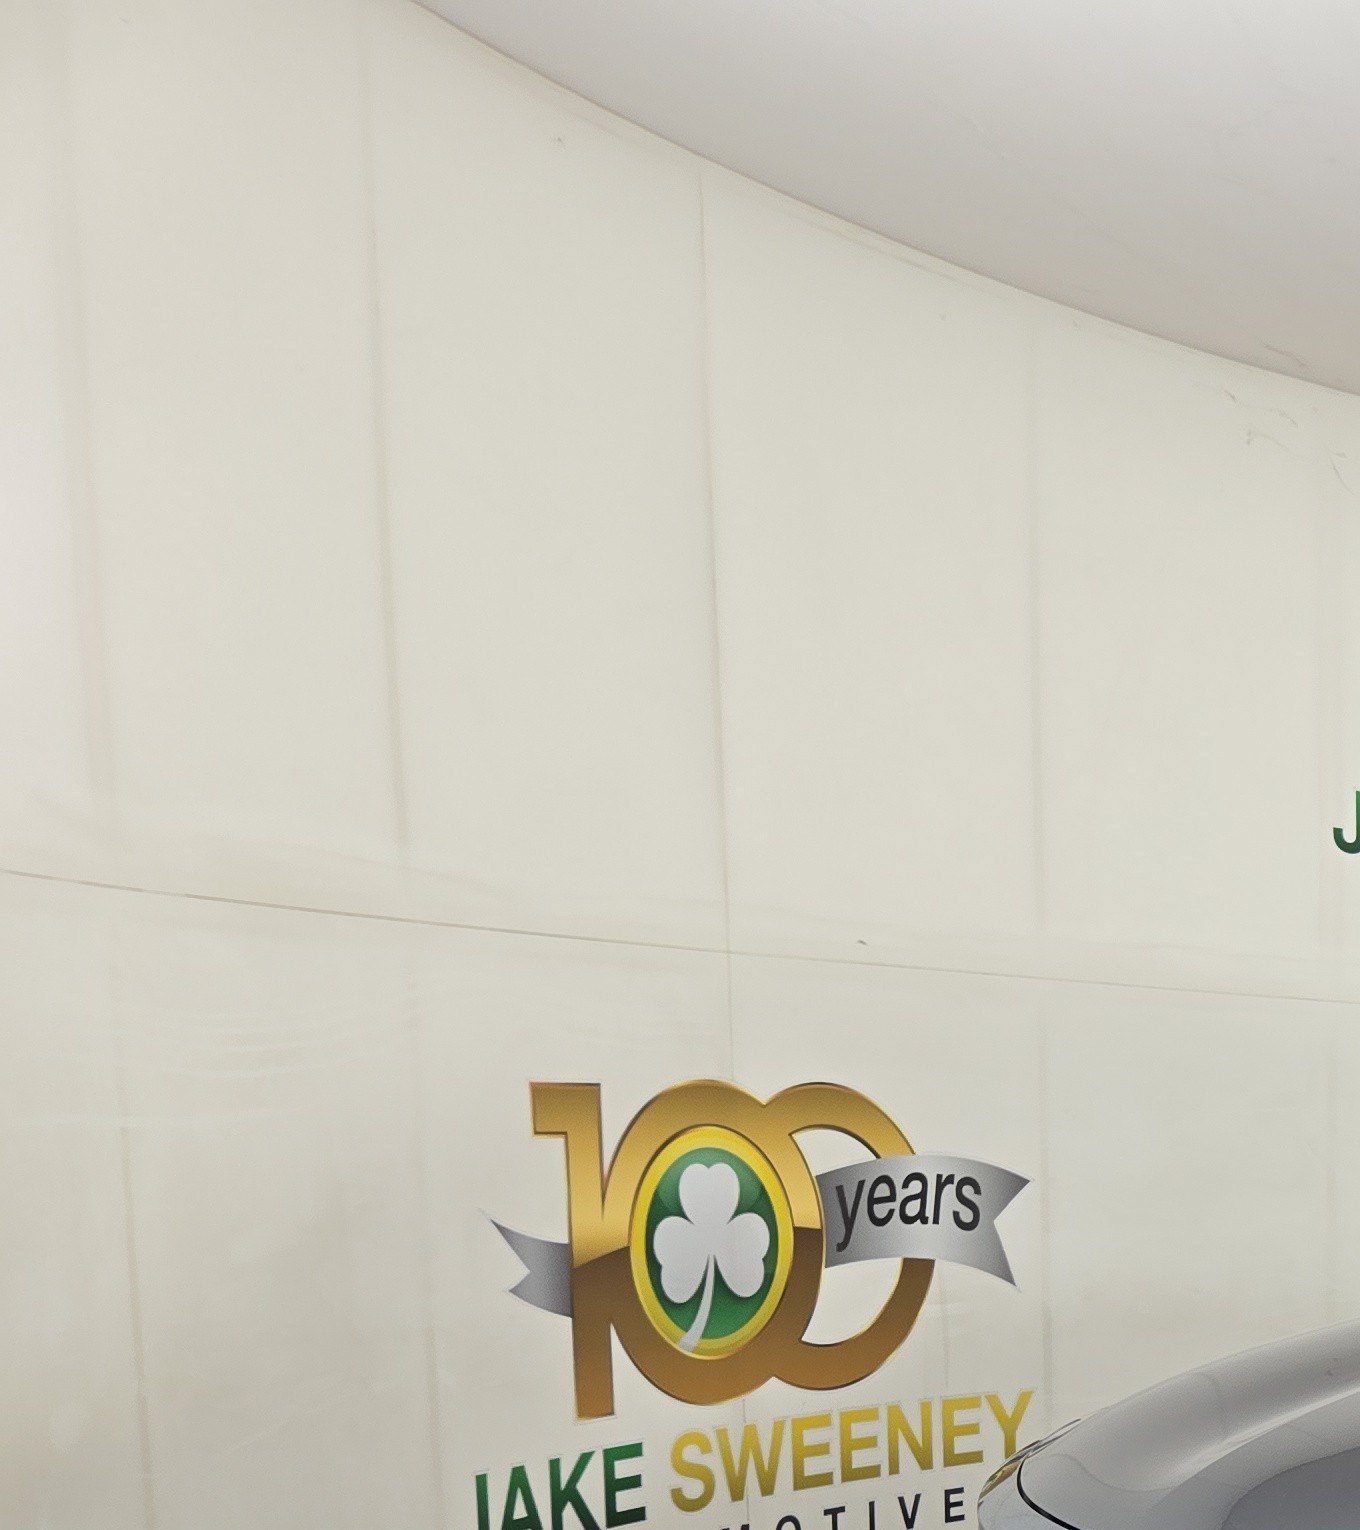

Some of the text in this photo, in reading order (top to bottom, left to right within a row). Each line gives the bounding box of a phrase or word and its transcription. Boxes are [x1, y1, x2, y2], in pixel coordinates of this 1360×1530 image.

[528, 1079, 936, 1421] 100
[836, 1172, 982, 1253] years
[669, 1390, 1034, 1513] SWEENEY
